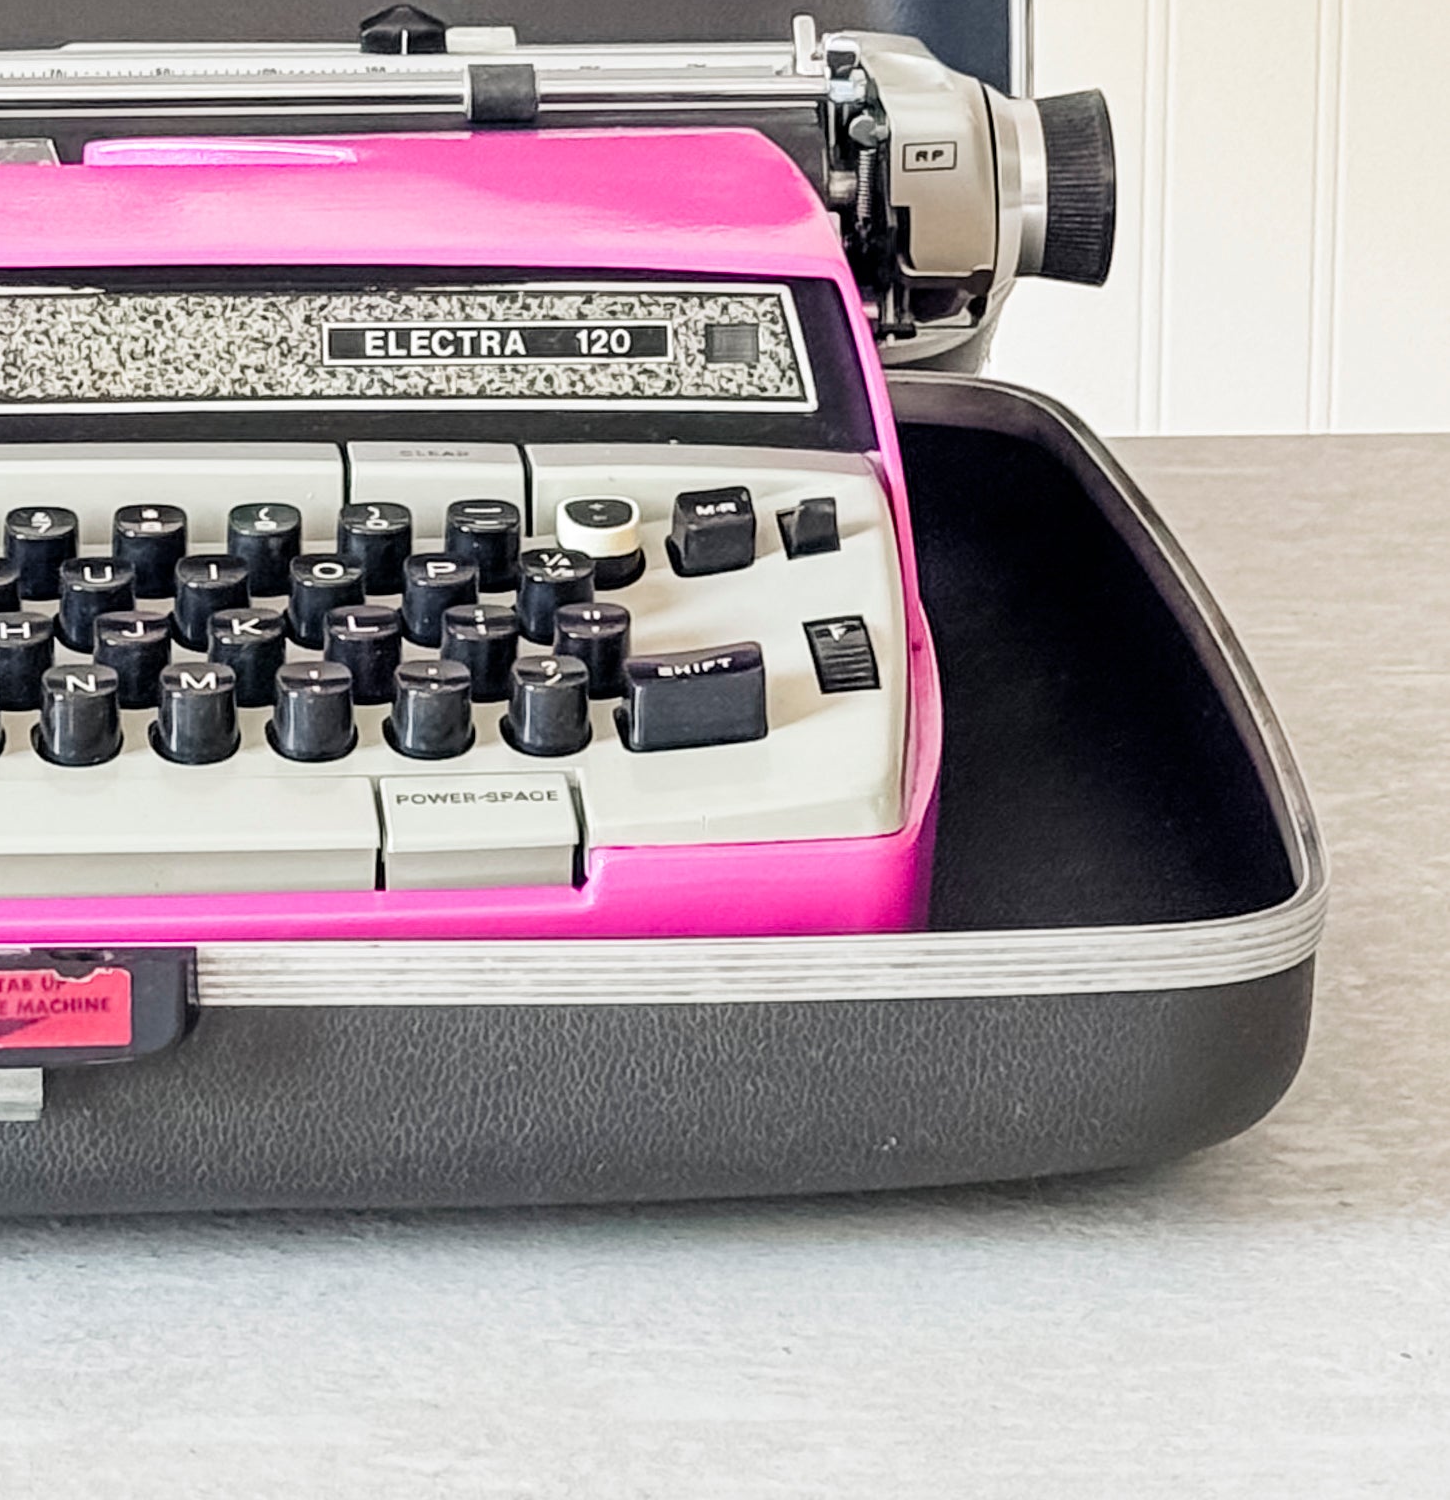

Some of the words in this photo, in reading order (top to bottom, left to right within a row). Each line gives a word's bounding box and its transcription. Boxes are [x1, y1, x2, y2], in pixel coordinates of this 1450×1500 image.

[364, 329, 527, 358] ELECTRA
[575, 328, 632, 356] 120
[82, 565, 113, 584] U
[208, 562, 219, 581] I
[311, 562, 345, 579] O
[426, 560, 458, 579] P
[120, 620, 145, 639] J
[230, 617, 264, 637] K
[346, 615, 380, 633] L
[657, 656, 733, 678] SHIFT
[65, 674, 97, 693] N
[178, 671, 218, 691] M
[395, 789, 559, 806] POWER-SPACE
[16, 996, 111, 1015] MACHINE
